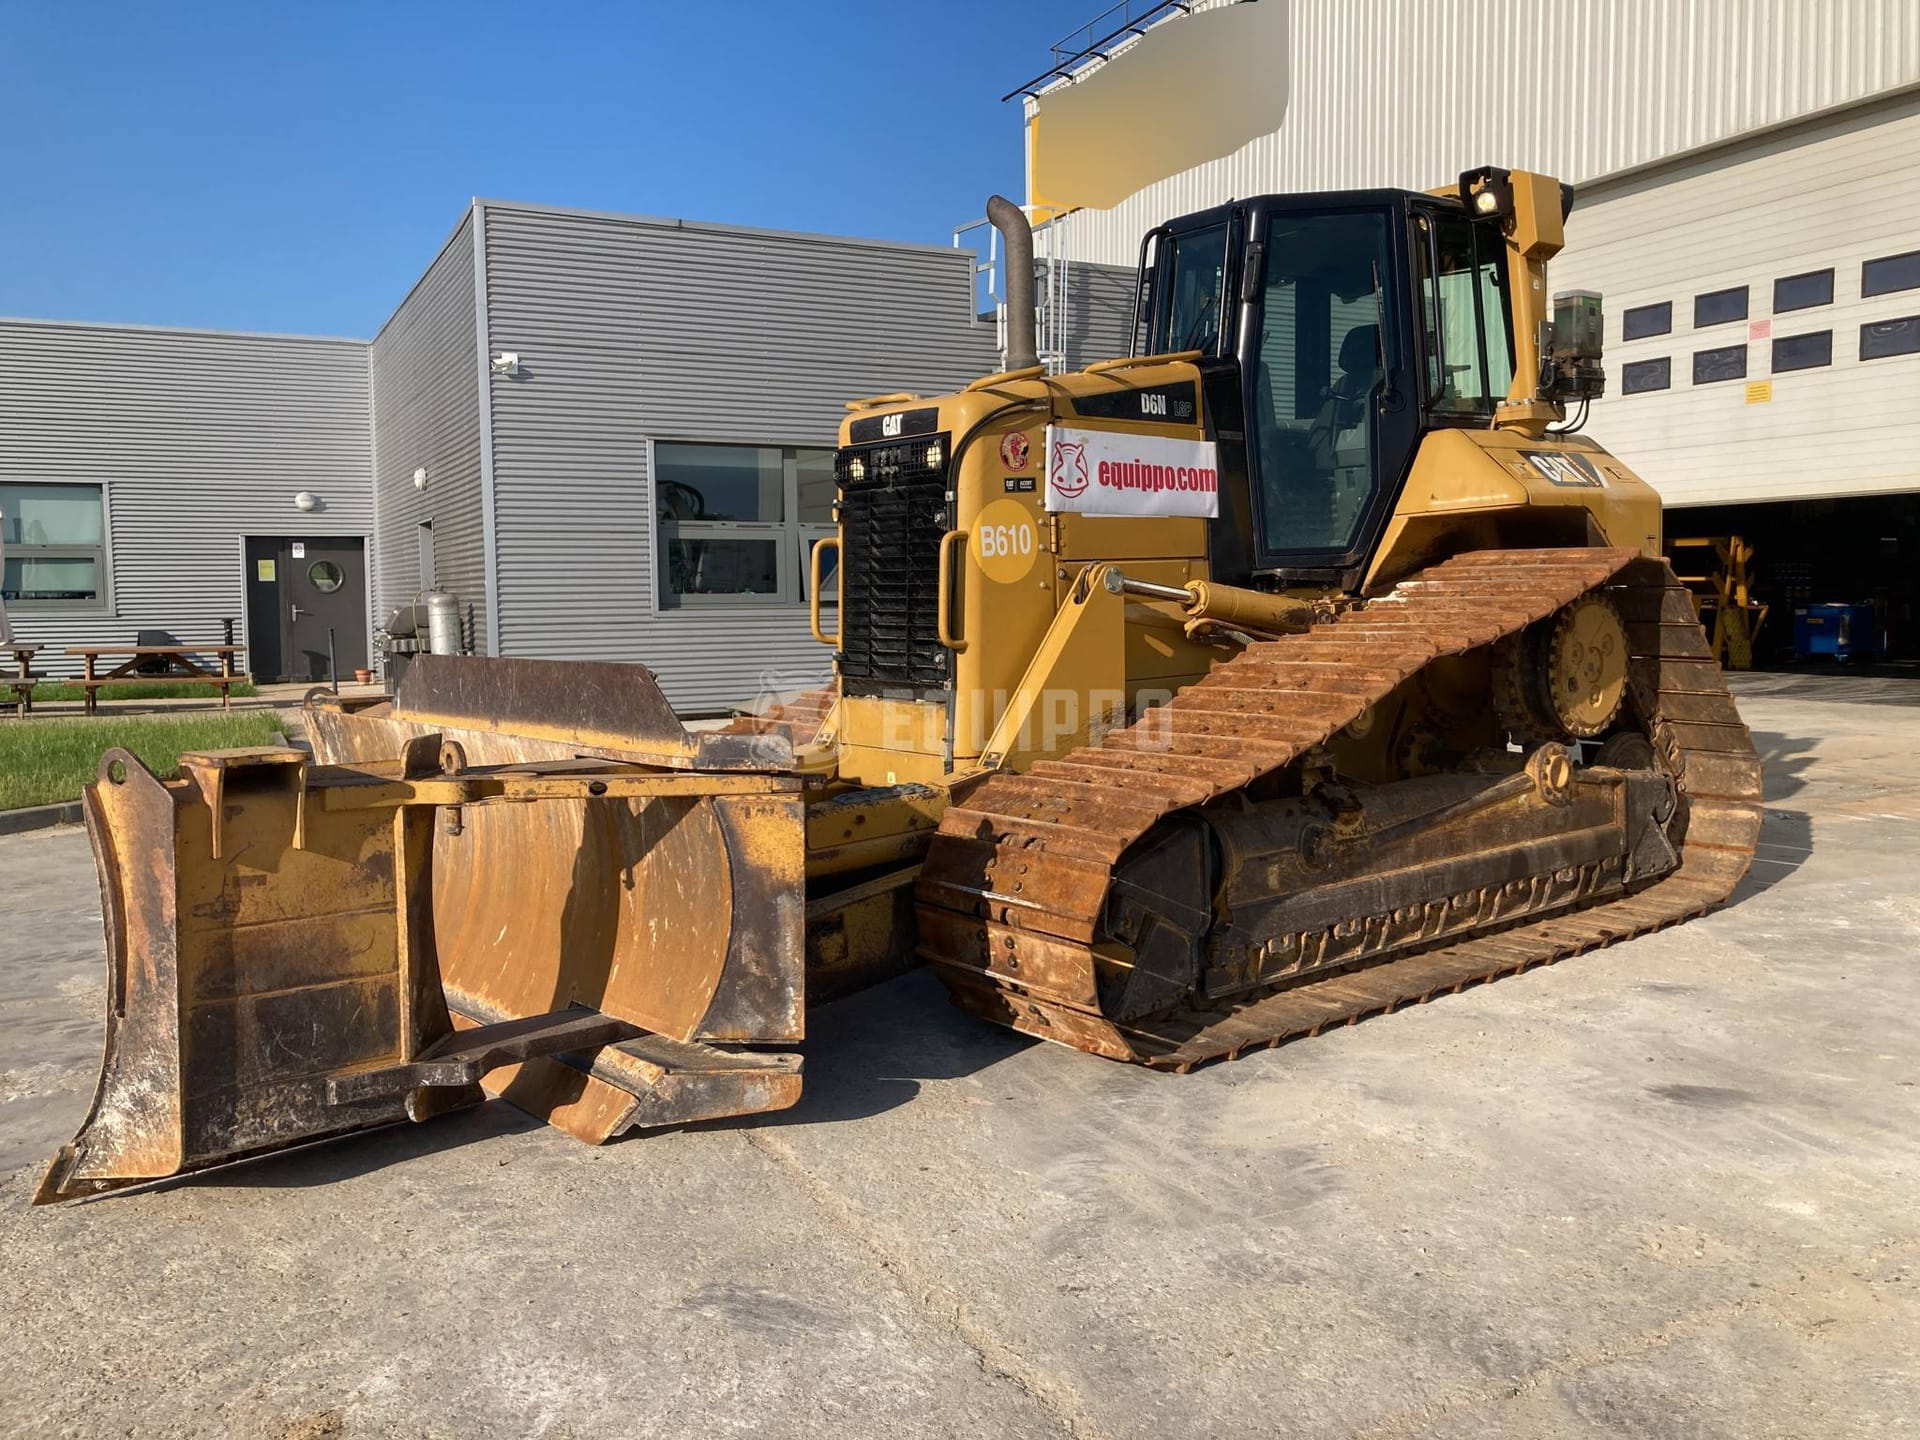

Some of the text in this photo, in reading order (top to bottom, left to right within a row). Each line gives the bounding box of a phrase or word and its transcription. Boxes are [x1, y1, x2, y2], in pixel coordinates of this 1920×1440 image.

[1141, 393, 1166, 415] D6N
[882, 413, 903, 436] CAT
[1098, 458, 1217, 492] equippo.com
[1530, 455, 1588, 483] CAT
[980, 524, 1031, 557] B610
